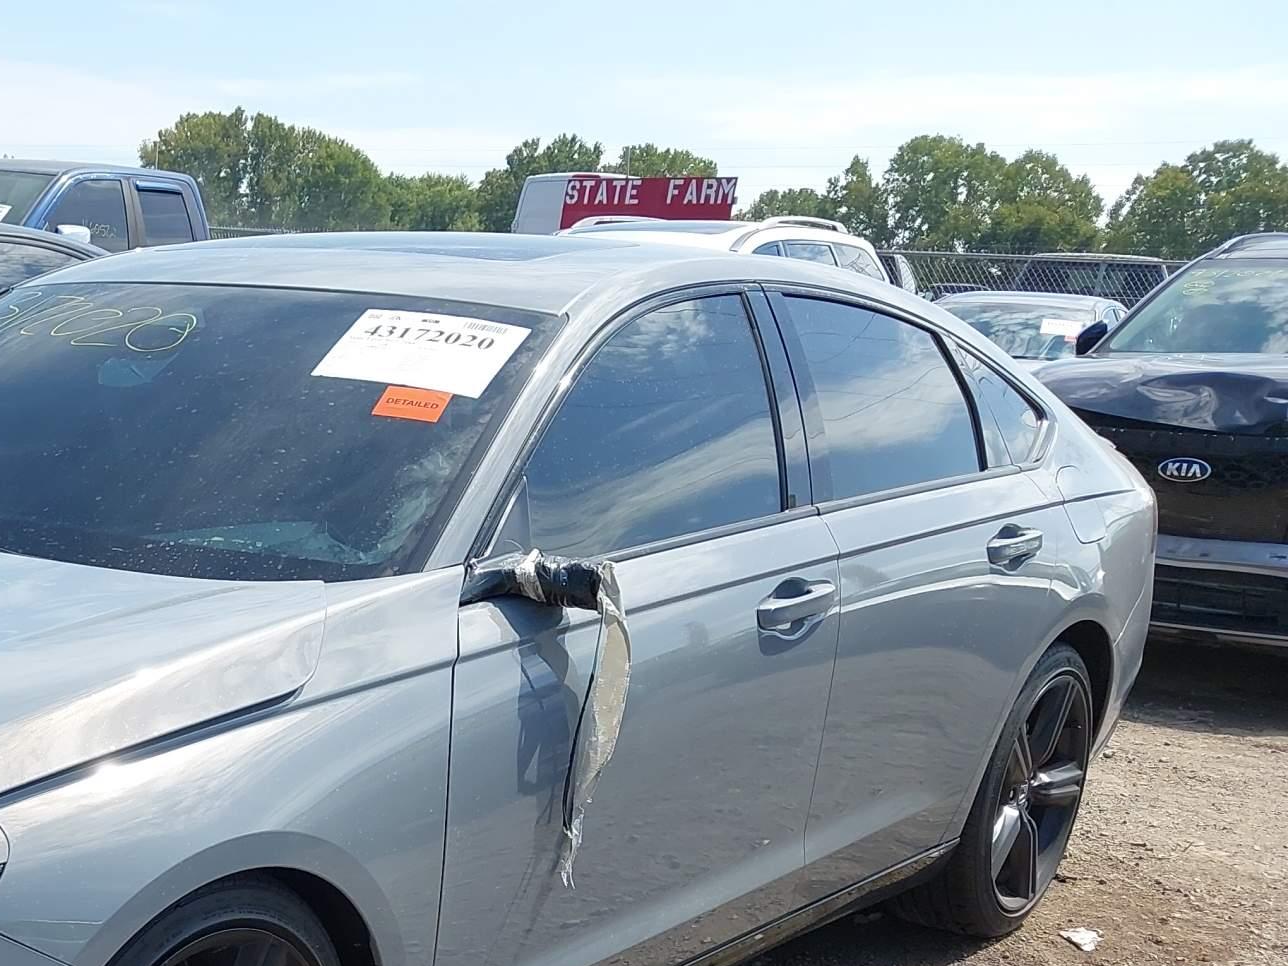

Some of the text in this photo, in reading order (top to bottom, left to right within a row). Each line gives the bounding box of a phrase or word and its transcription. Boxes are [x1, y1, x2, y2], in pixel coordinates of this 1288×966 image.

[565, 178, 736, 206] STATE FARM
[363, 323, 496, 351] 43172020
[385, 396, 440, 411] DETAILED
[1166, 462, 1202, 478] KIA
